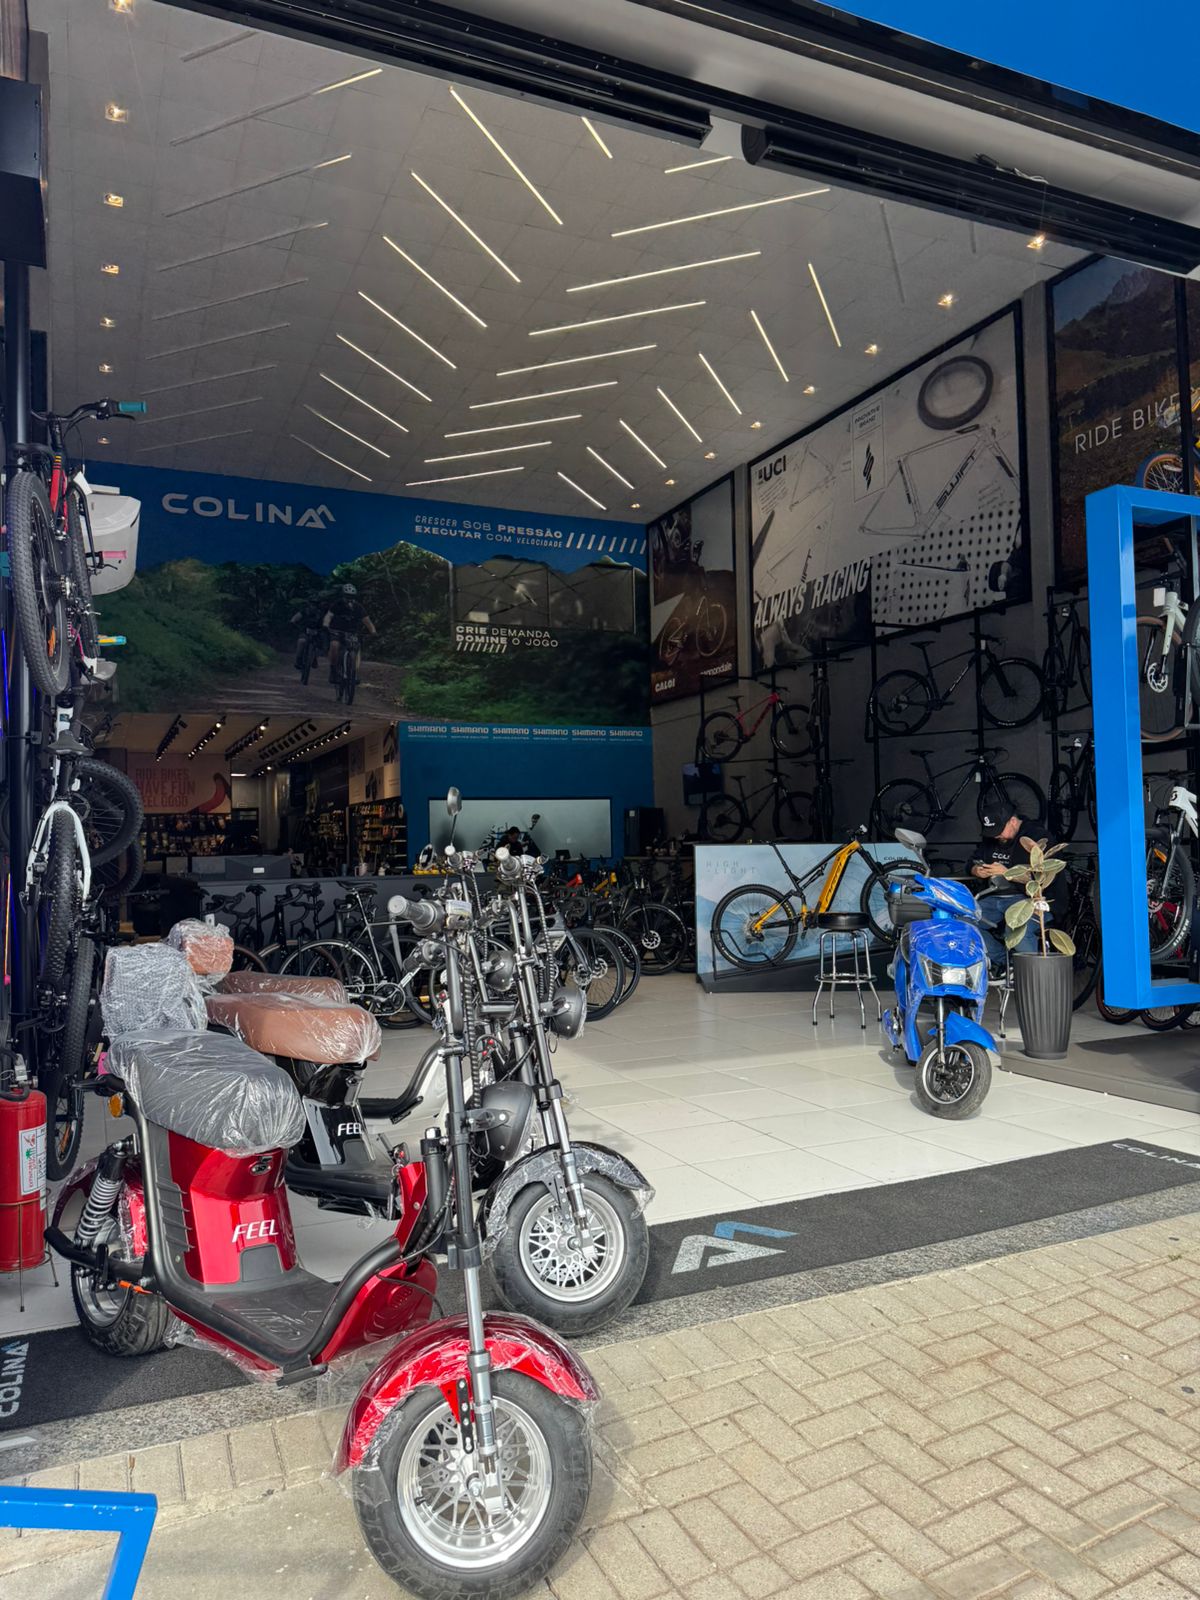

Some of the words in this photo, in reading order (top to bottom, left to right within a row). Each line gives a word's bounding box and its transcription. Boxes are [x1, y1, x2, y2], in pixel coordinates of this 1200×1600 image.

[1075, 417, 1122, 454] RIDE
[763, 455, 786, 482] UCI
[161, 493, 336, 529] COLINA
[415, 515, 457, 527] CRESCER
[463, 520, 492, 531] SOB
[498, 524, 563, 539] PRESSÃO
[415, 525, 481, 539] EXECUTAR
[486, 533, 512, 543] COM
[516, 537, 563, 548] VELOCIDADE
[754, 582, 807, 628] ALWAYS
[811, 557, 871, 610] RACING
[456, 626, 487, 635] CRIE
[491, 628, 551, 639] DEMANDA
[456, 634, 508, 644] DOMINE
[511, 637, 521, 646] O
[525, 638, 559, 648] JOGO
[655, 678, 676, 693] CALOI
[408, 725, 447, 733] SHIMANO
[451, 726, 489, 734] SHIMANO
[492, 727, 529, 735] SHIMANO
[532, 728, 568, 736] SHIMANO
[571, 729, 606, 737] SHIMANO
[171, 781, 196, 796] FUN
[232, 1219, 279, 1243] FEEL
[0, 1341, 29, 1418] COLINA
